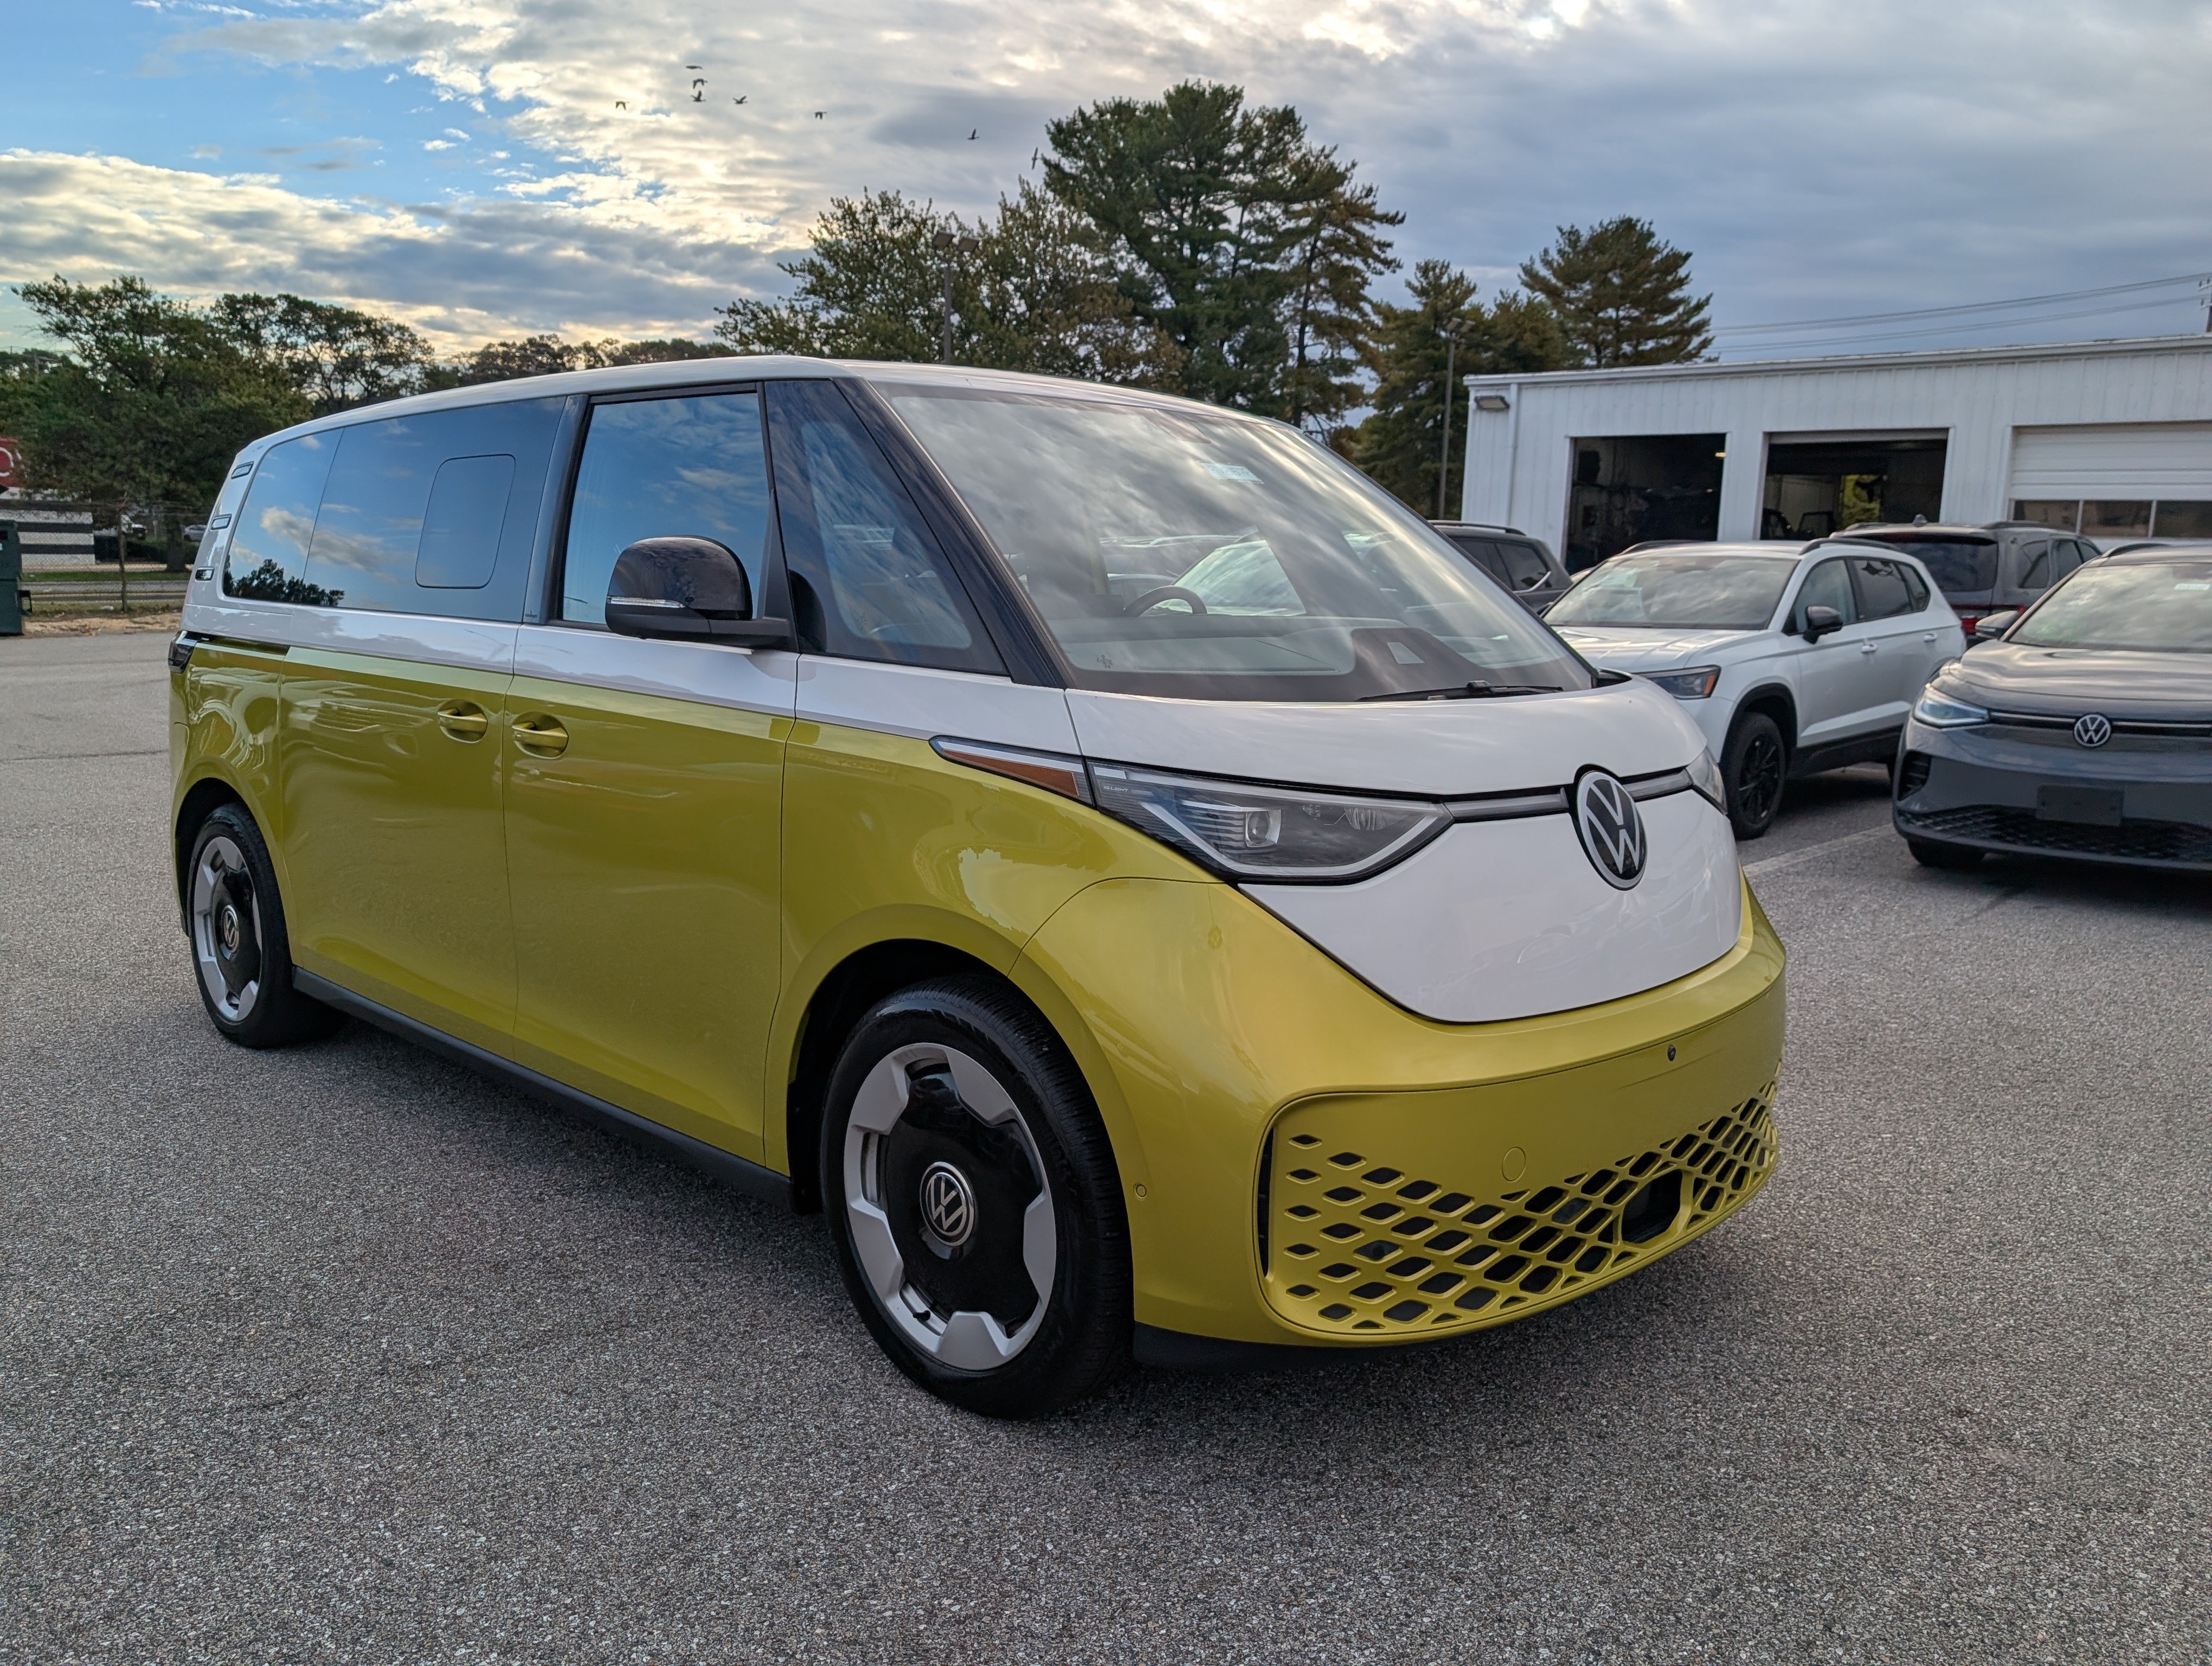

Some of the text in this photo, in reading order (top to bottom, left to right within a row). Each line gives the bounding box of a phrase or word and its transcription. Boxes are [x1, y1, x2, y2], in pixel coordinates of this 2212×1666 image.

[2076, 715, 2108, 744] VW
[1583, 777, 1643, 877] VW
[223, 911, 237, 947] VW
[925, 1172, 968, 1233] VW
